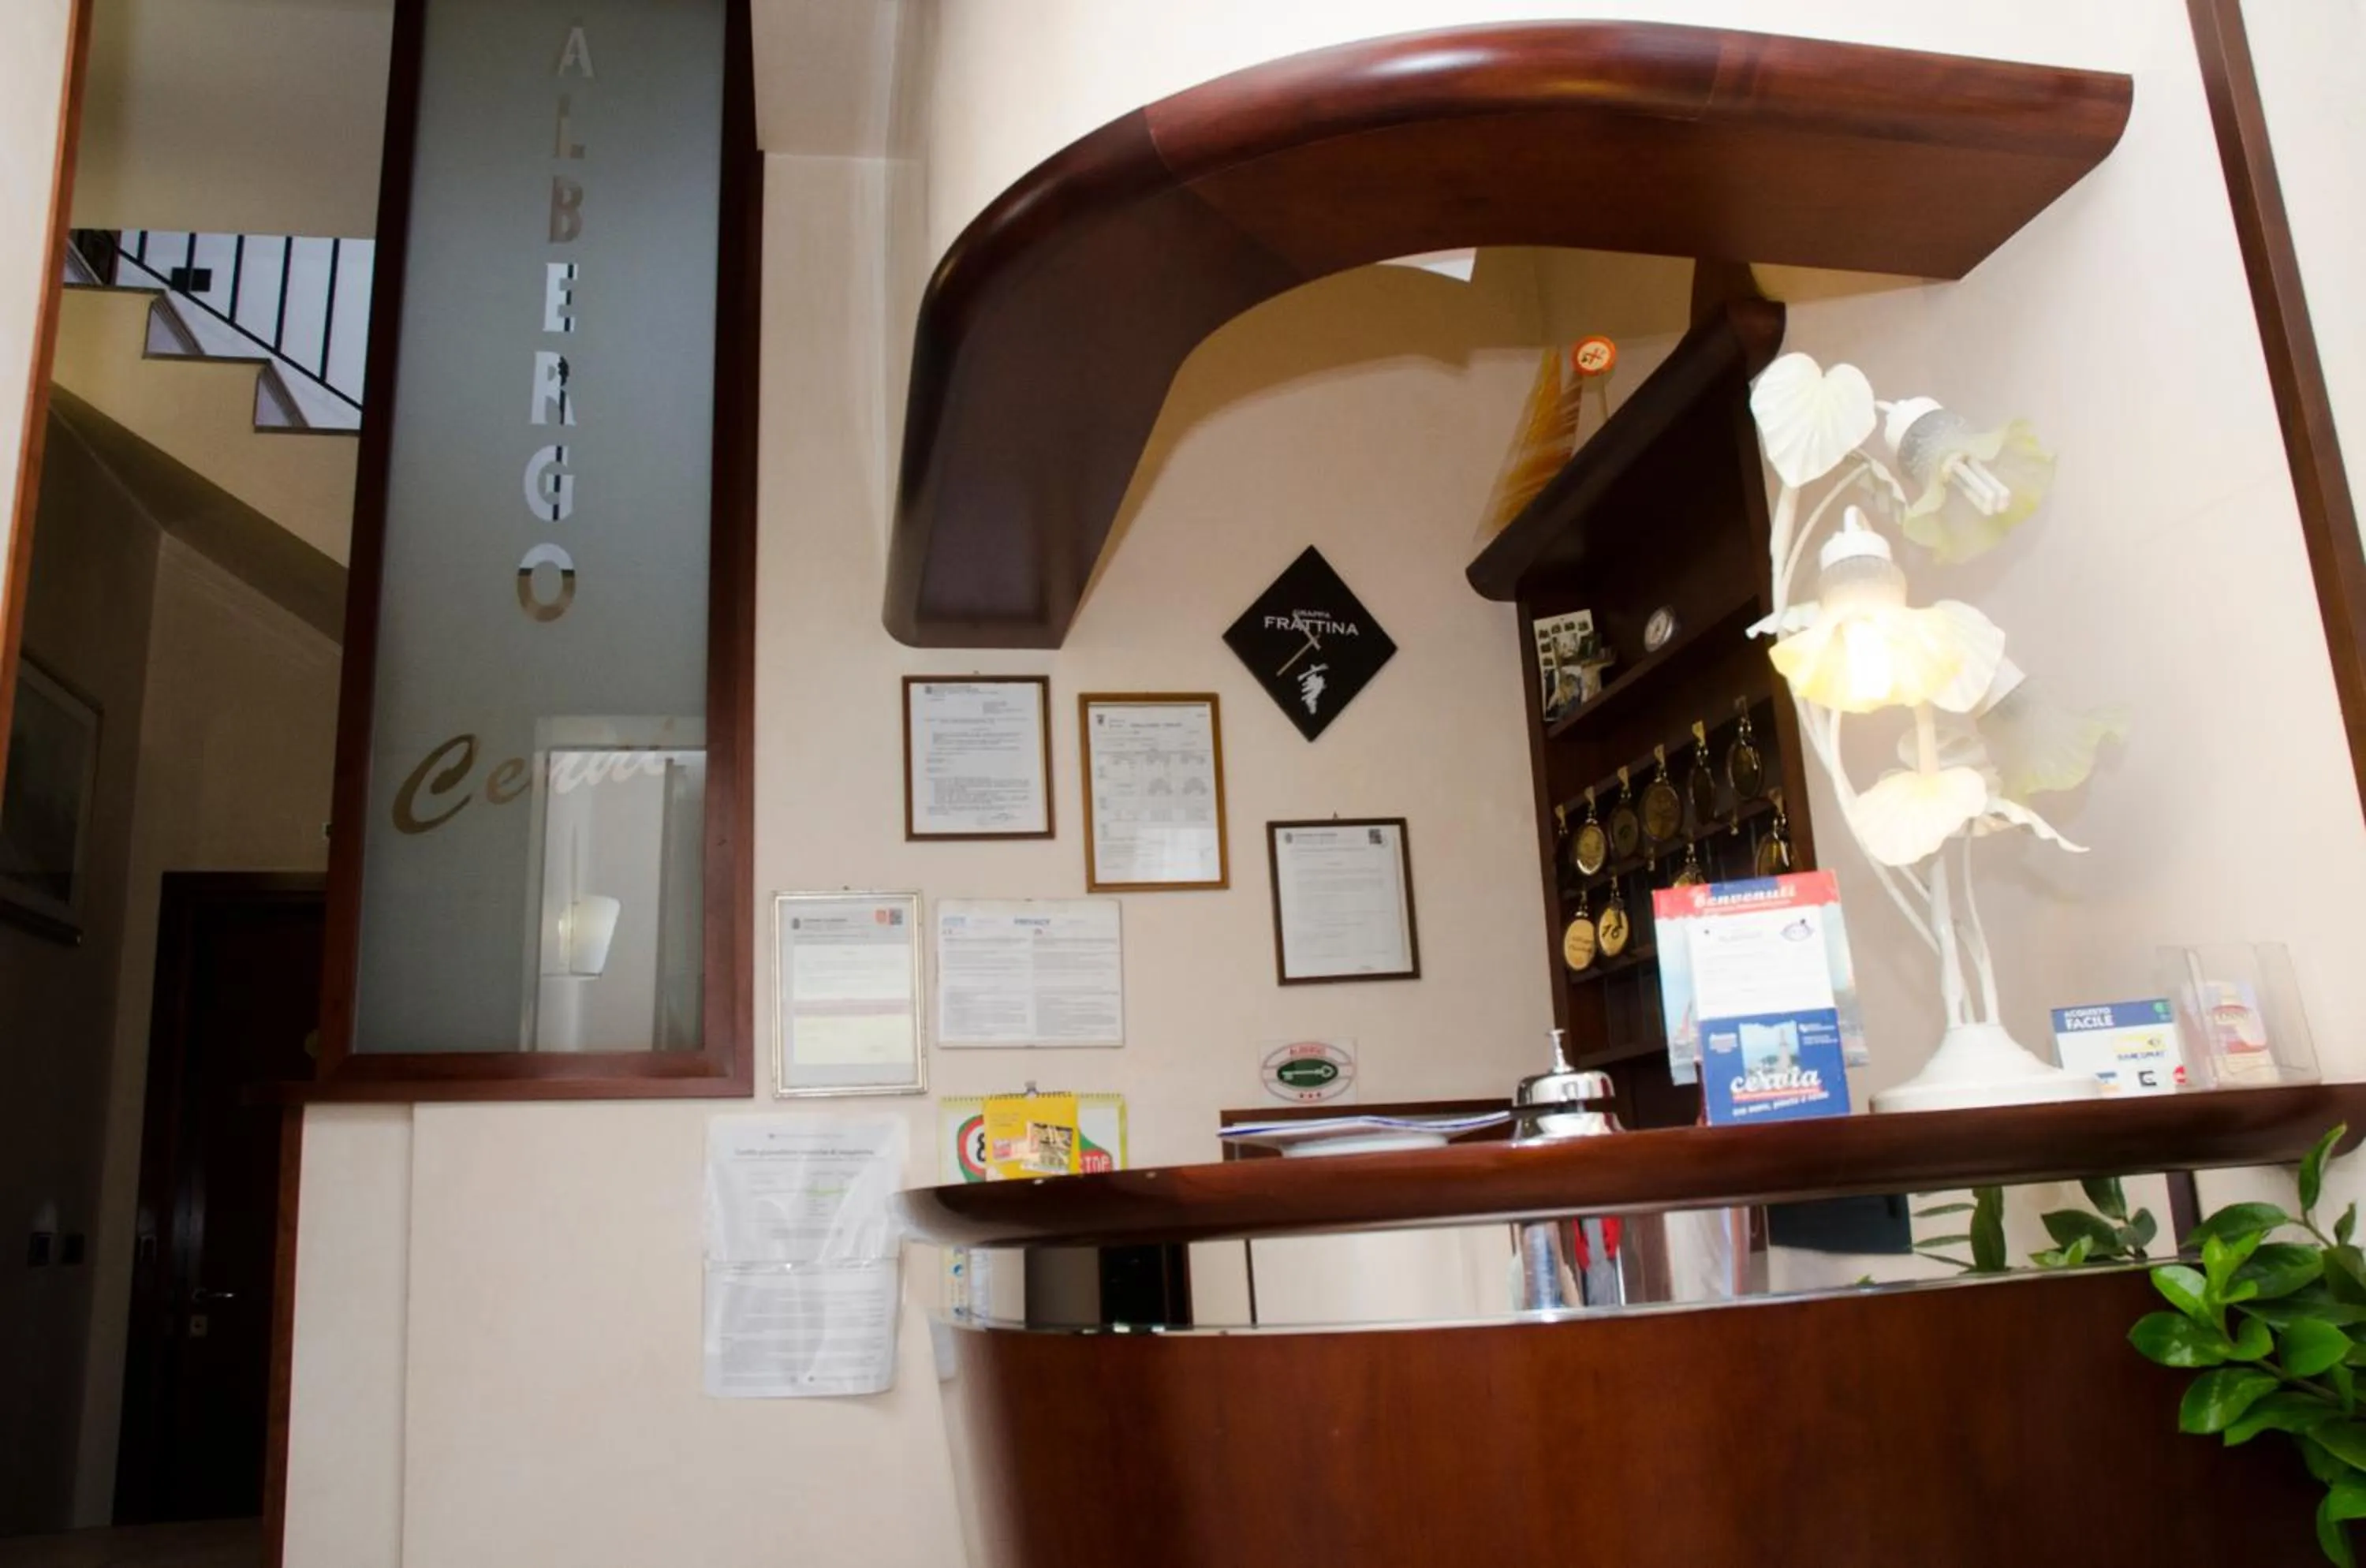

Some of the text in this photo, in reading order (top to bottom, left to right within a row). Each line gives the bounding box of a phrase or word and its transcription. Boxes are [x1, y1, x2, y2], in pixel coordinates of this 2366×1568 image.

[517, 17, 594, 623] ALBERGO
[1263, 615, 1360, 637] FRATTINA
[2066, 1014, 2115, 1031] FACILE
